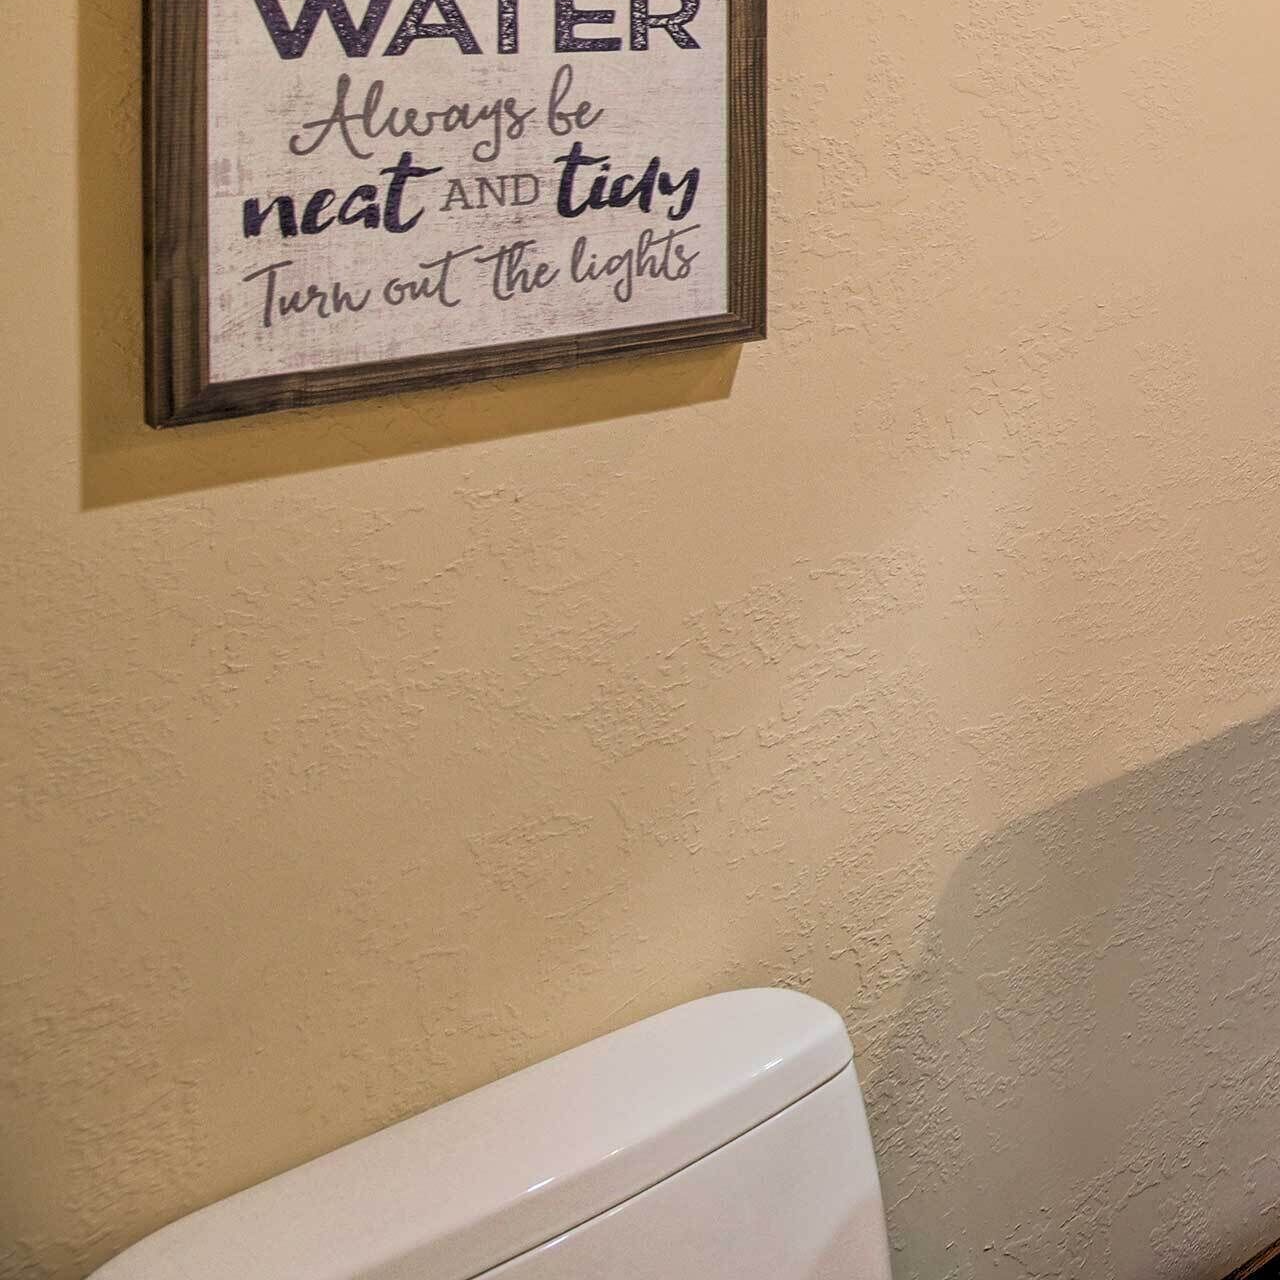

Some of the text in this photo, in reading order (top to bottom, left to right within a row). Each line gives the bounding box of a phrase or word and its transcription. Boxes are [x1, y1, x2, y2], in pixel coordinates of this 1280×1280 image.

[289, 63, 605, 163] Always be
[242, 141, 701, 238] neat AND tidy
[242, 223, 702, 328] Turn out the lights
